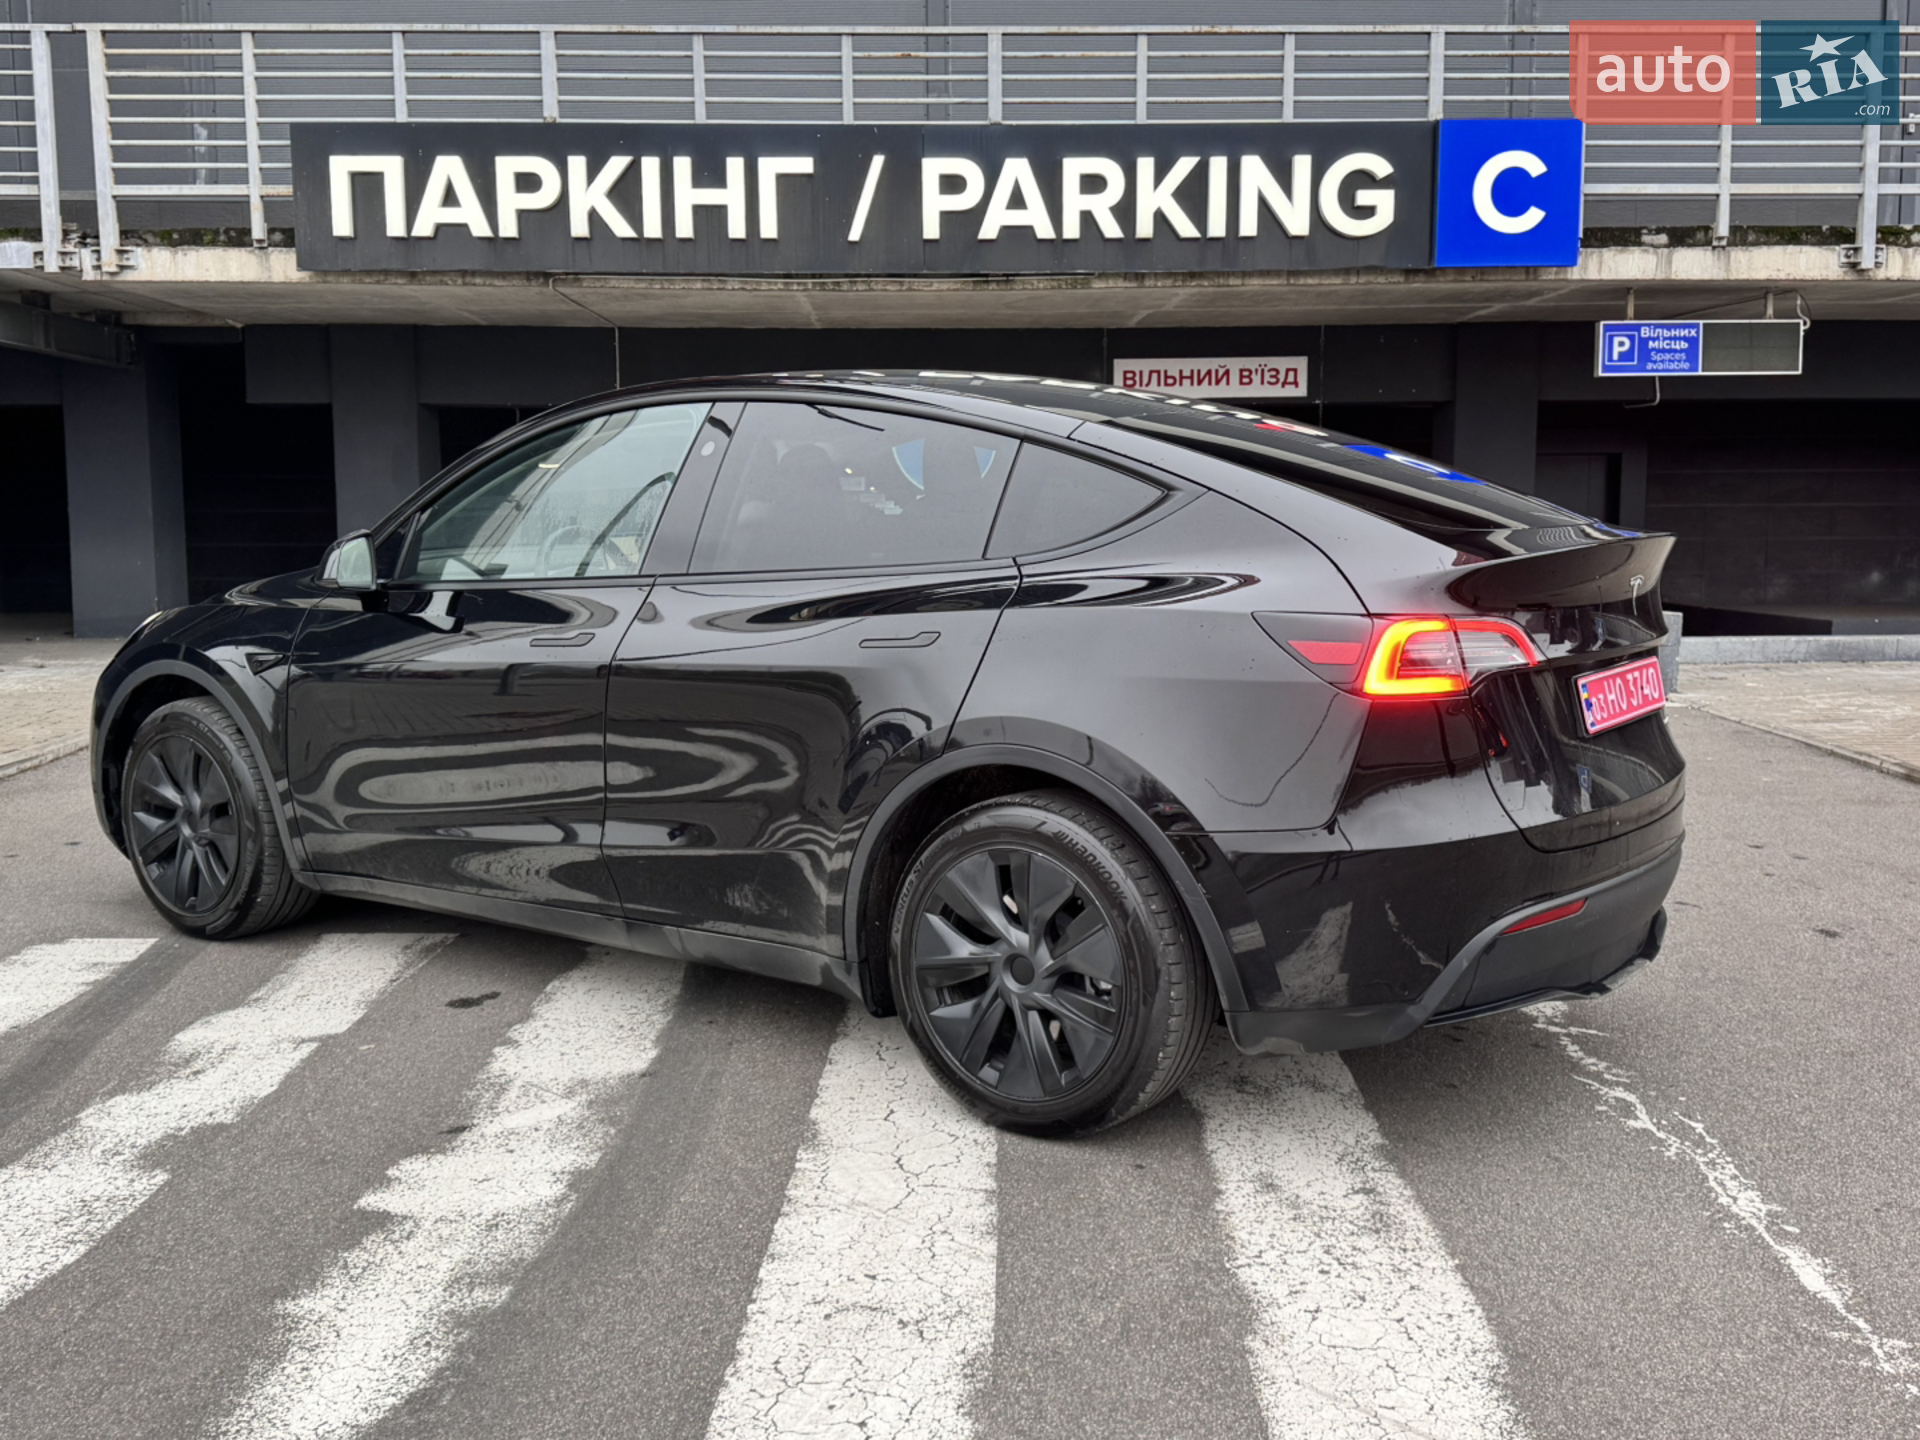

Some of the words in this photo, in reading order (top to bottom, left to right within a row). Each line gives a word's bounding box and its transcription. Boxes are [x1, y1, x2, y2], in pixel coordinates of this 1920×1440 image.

[328, 154, 815, 240] ПАРКІНГ
[846, 154, 886, 242] /
[921, 152, 1397, 240] PARKING
[1472, 150, 1548, 234] C
[1640, 326, 1697, 338] Вільних
[1648, 337, 1689, 350] місць
[1646, 360, 1690, 371] available
[1650, 351, 1687, 362] Spaces
[1122, 364, 1230, 388] ВІЛЬНИЙ
[1625, 667, 1659, 707] 3740
